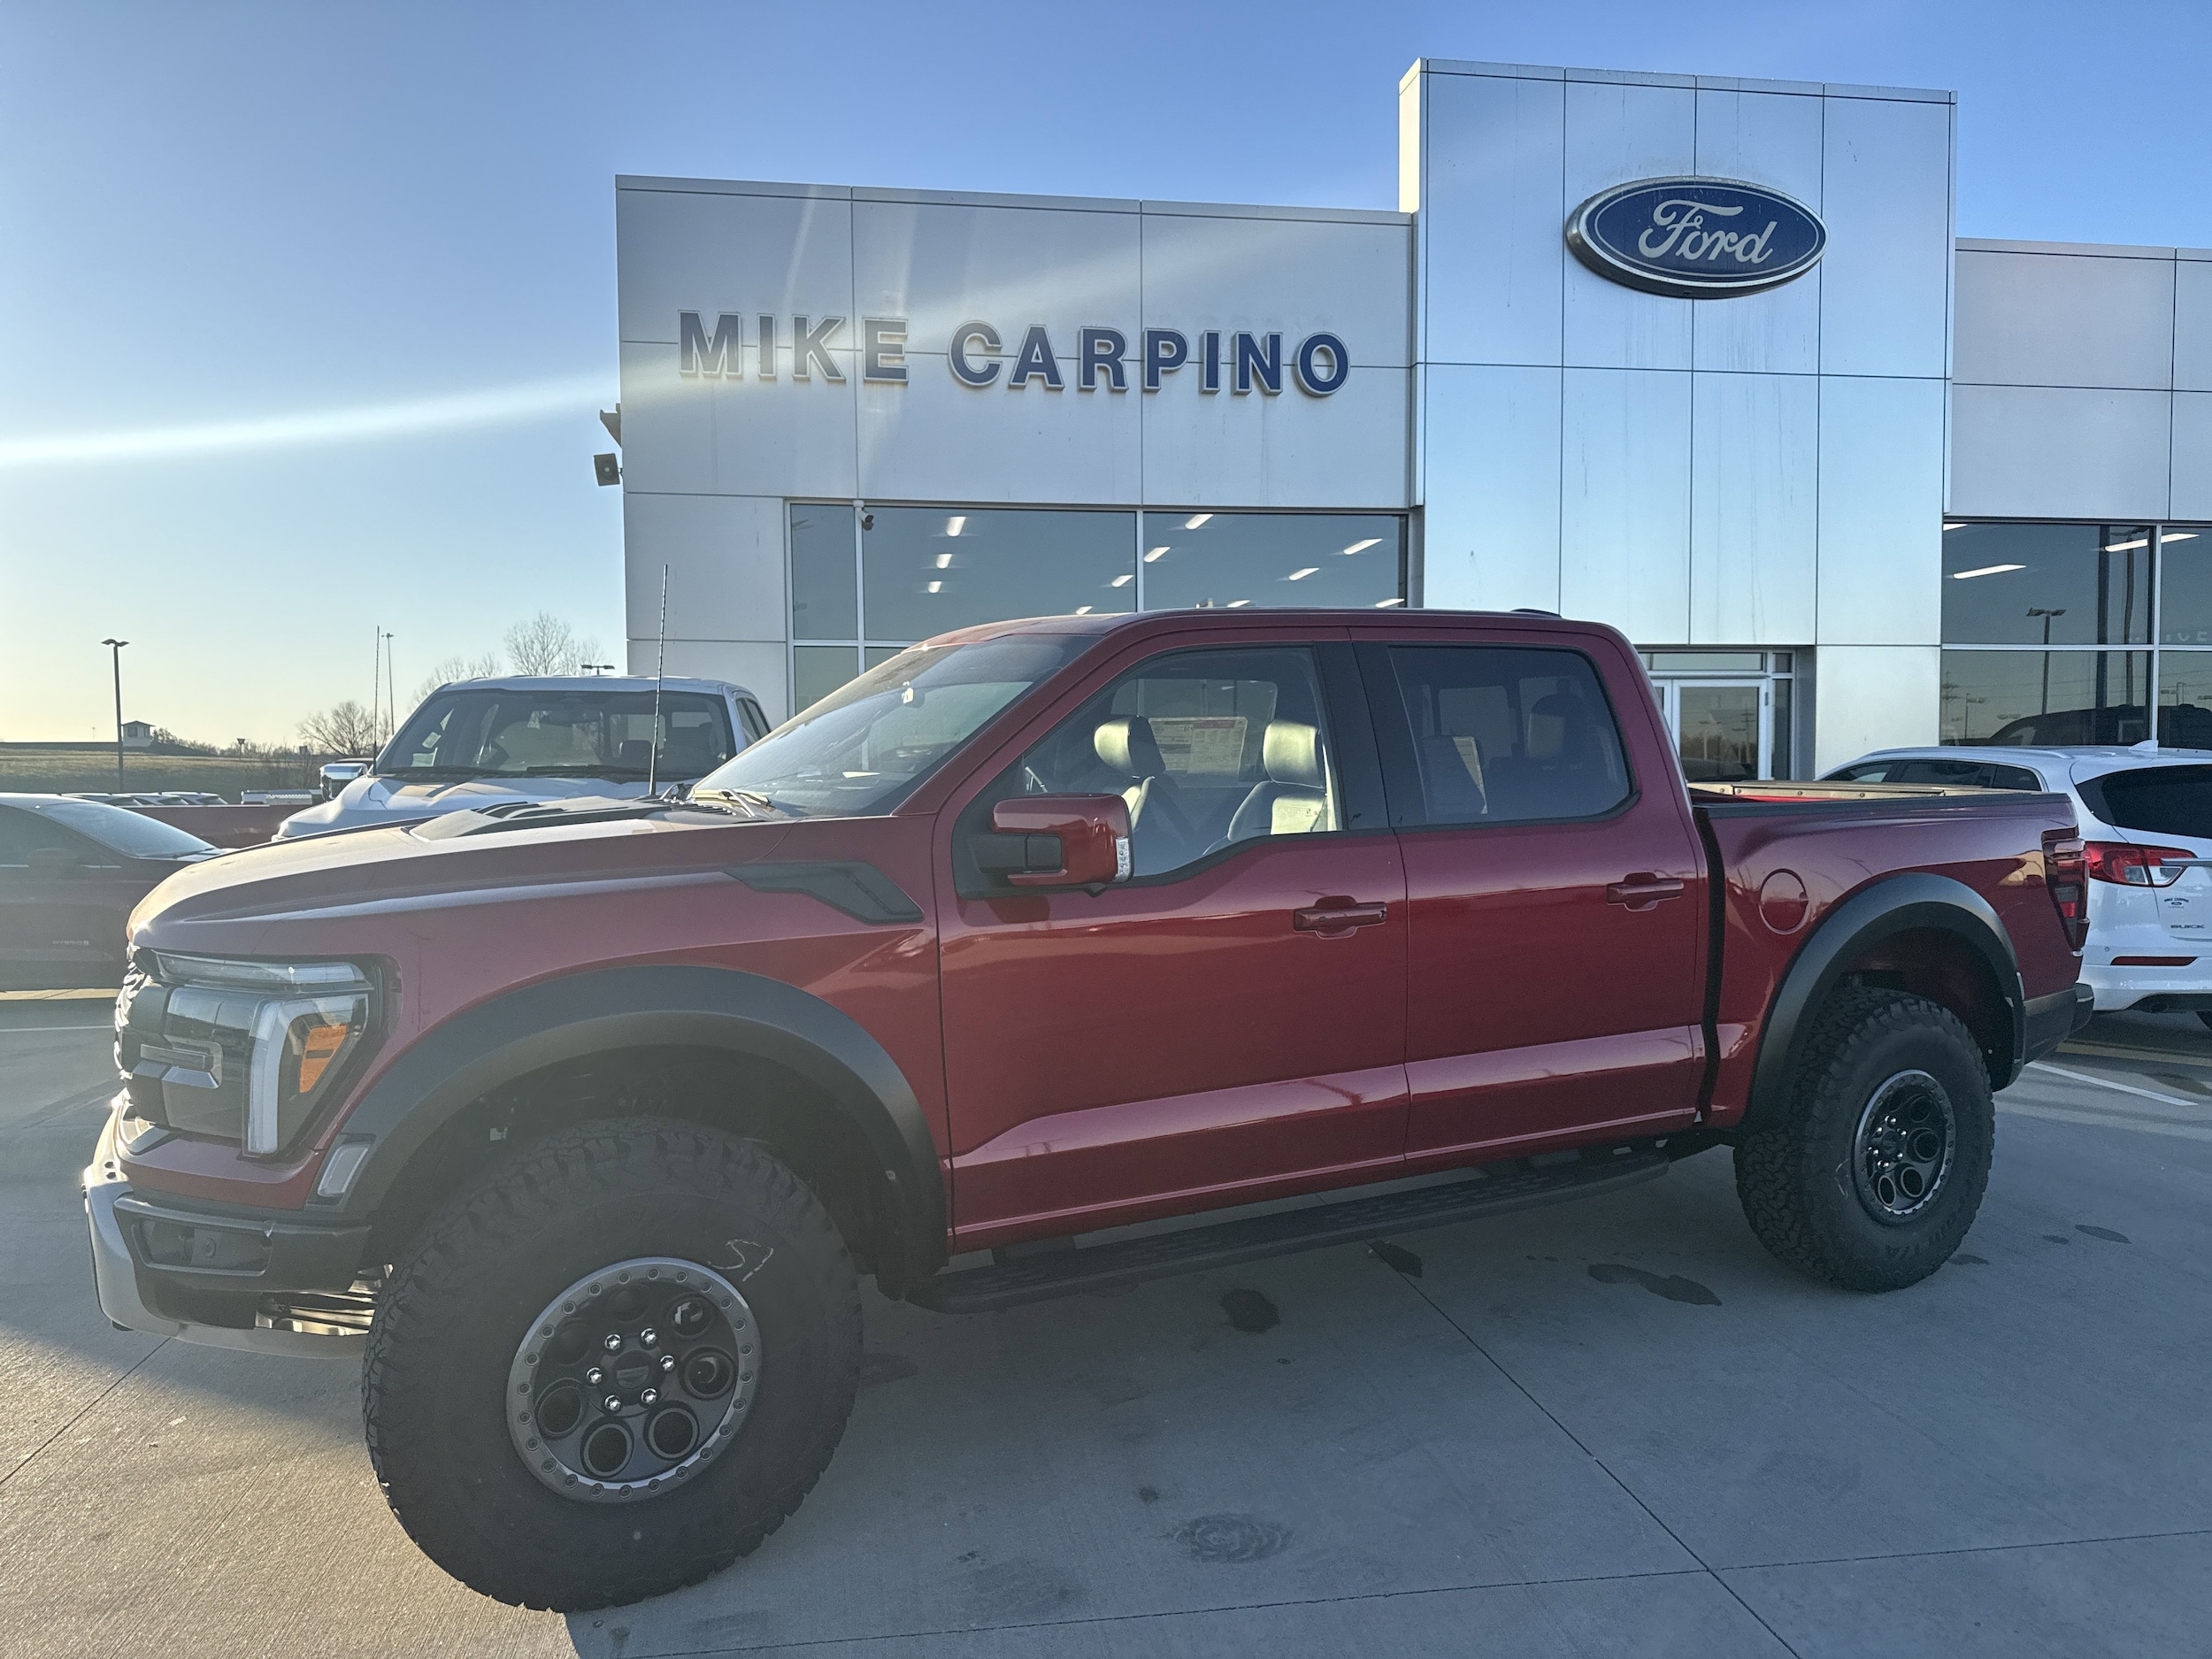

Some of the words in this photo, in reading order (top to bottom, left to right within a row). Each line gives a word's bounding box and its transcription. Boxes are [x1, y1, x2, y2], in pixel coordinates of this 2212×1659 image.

[1638, 199, 1778, 265] Ford
[679, 310, 909, 384] MIKE
[948, 319, 1351, 397] CARPINO
